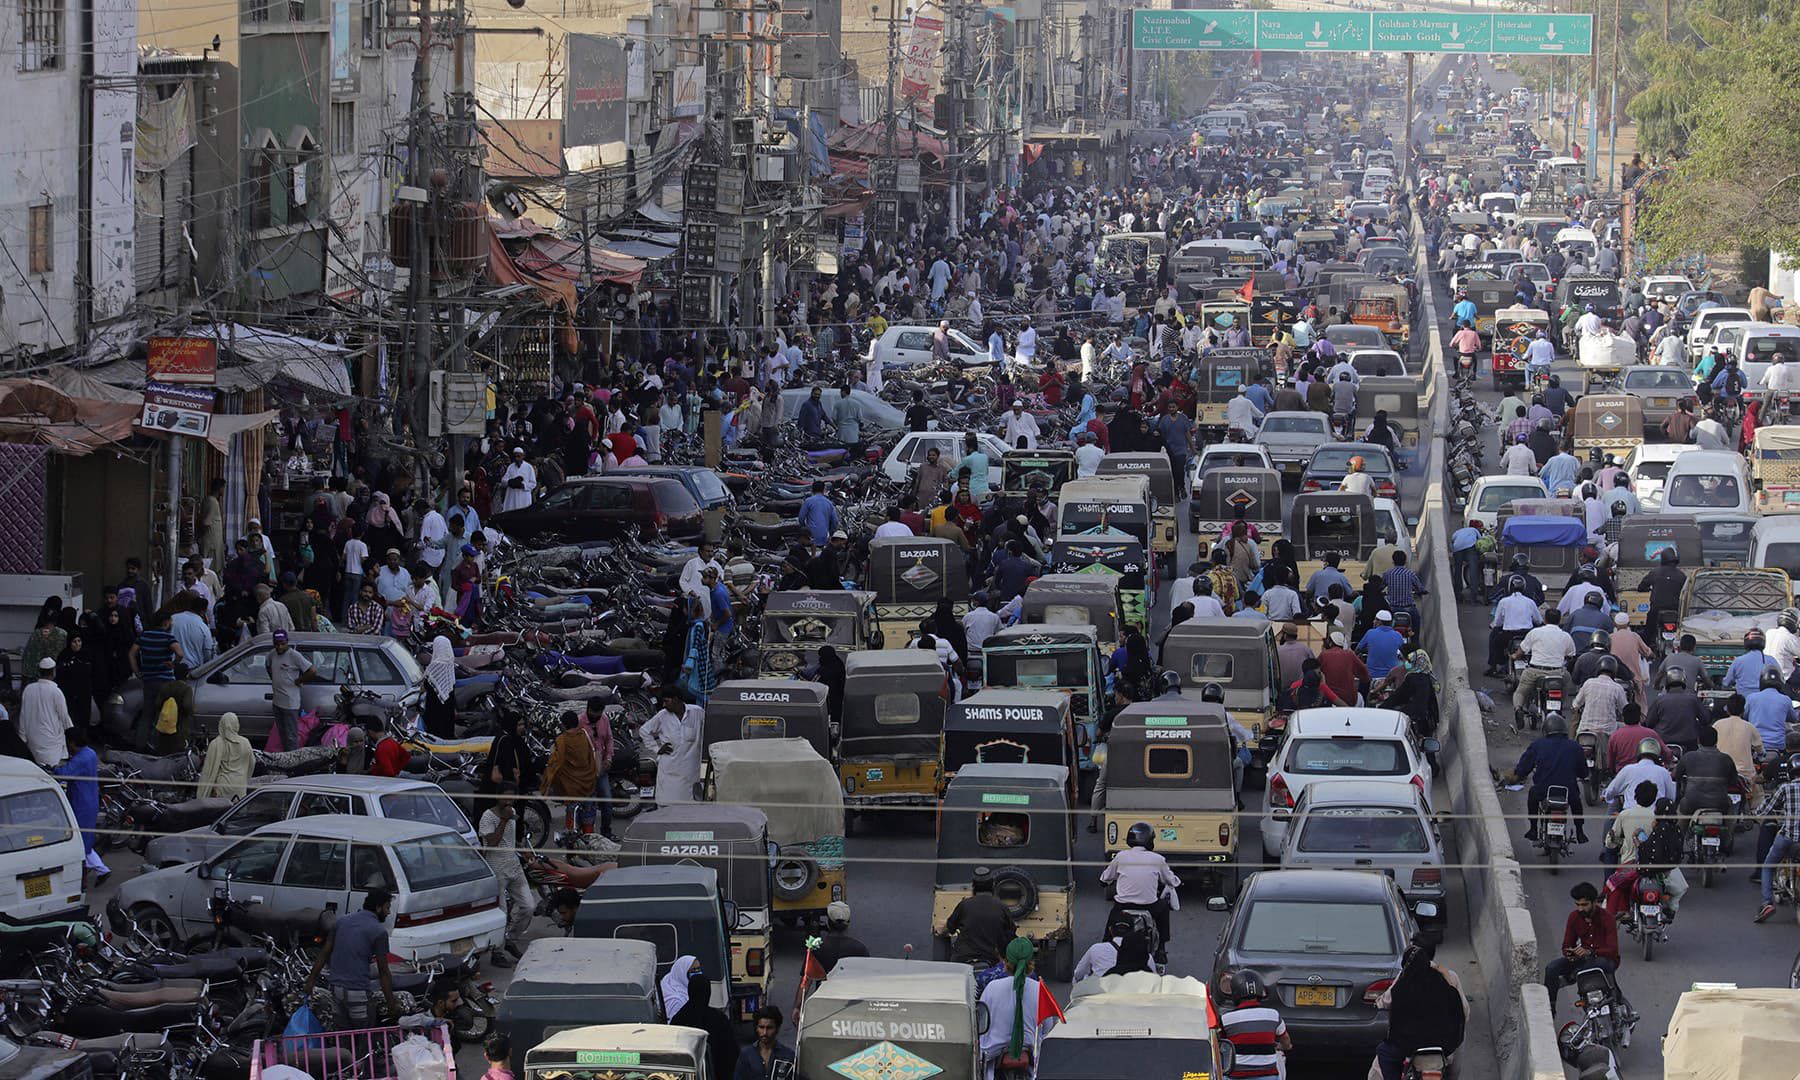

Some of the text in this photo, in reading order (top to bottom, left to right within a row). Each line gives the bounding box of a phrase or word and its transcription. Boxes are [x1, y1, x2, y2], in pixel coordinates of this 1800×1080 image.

[1143, 16, 1191, 25] Nazimabad
[1261, 19, 1281, 30] Naya
[1497, 21, 1532, 30] Hyderabad
[1142, 35, 1192, 45] Civic Center
[1261, 31, 1304, 40] Nazimabad
[1378, 31, 1441, 41] Sohrab Goth
[1315, 506, 1351, 514] SAZGAR
[899, 550, 939, 558] SAZGAR
[791, 602, 832, 610] UNIQUE
[740, 692, 790, 703] SAZGAR
[964, 707, 1044, 721] SHAMS POWER
[1145, 729, 1192, 739] SAZGAR
[660, 844, 719, 857] SAZGAR
[831, 1020, 946, 1040] SHAMS POWER
